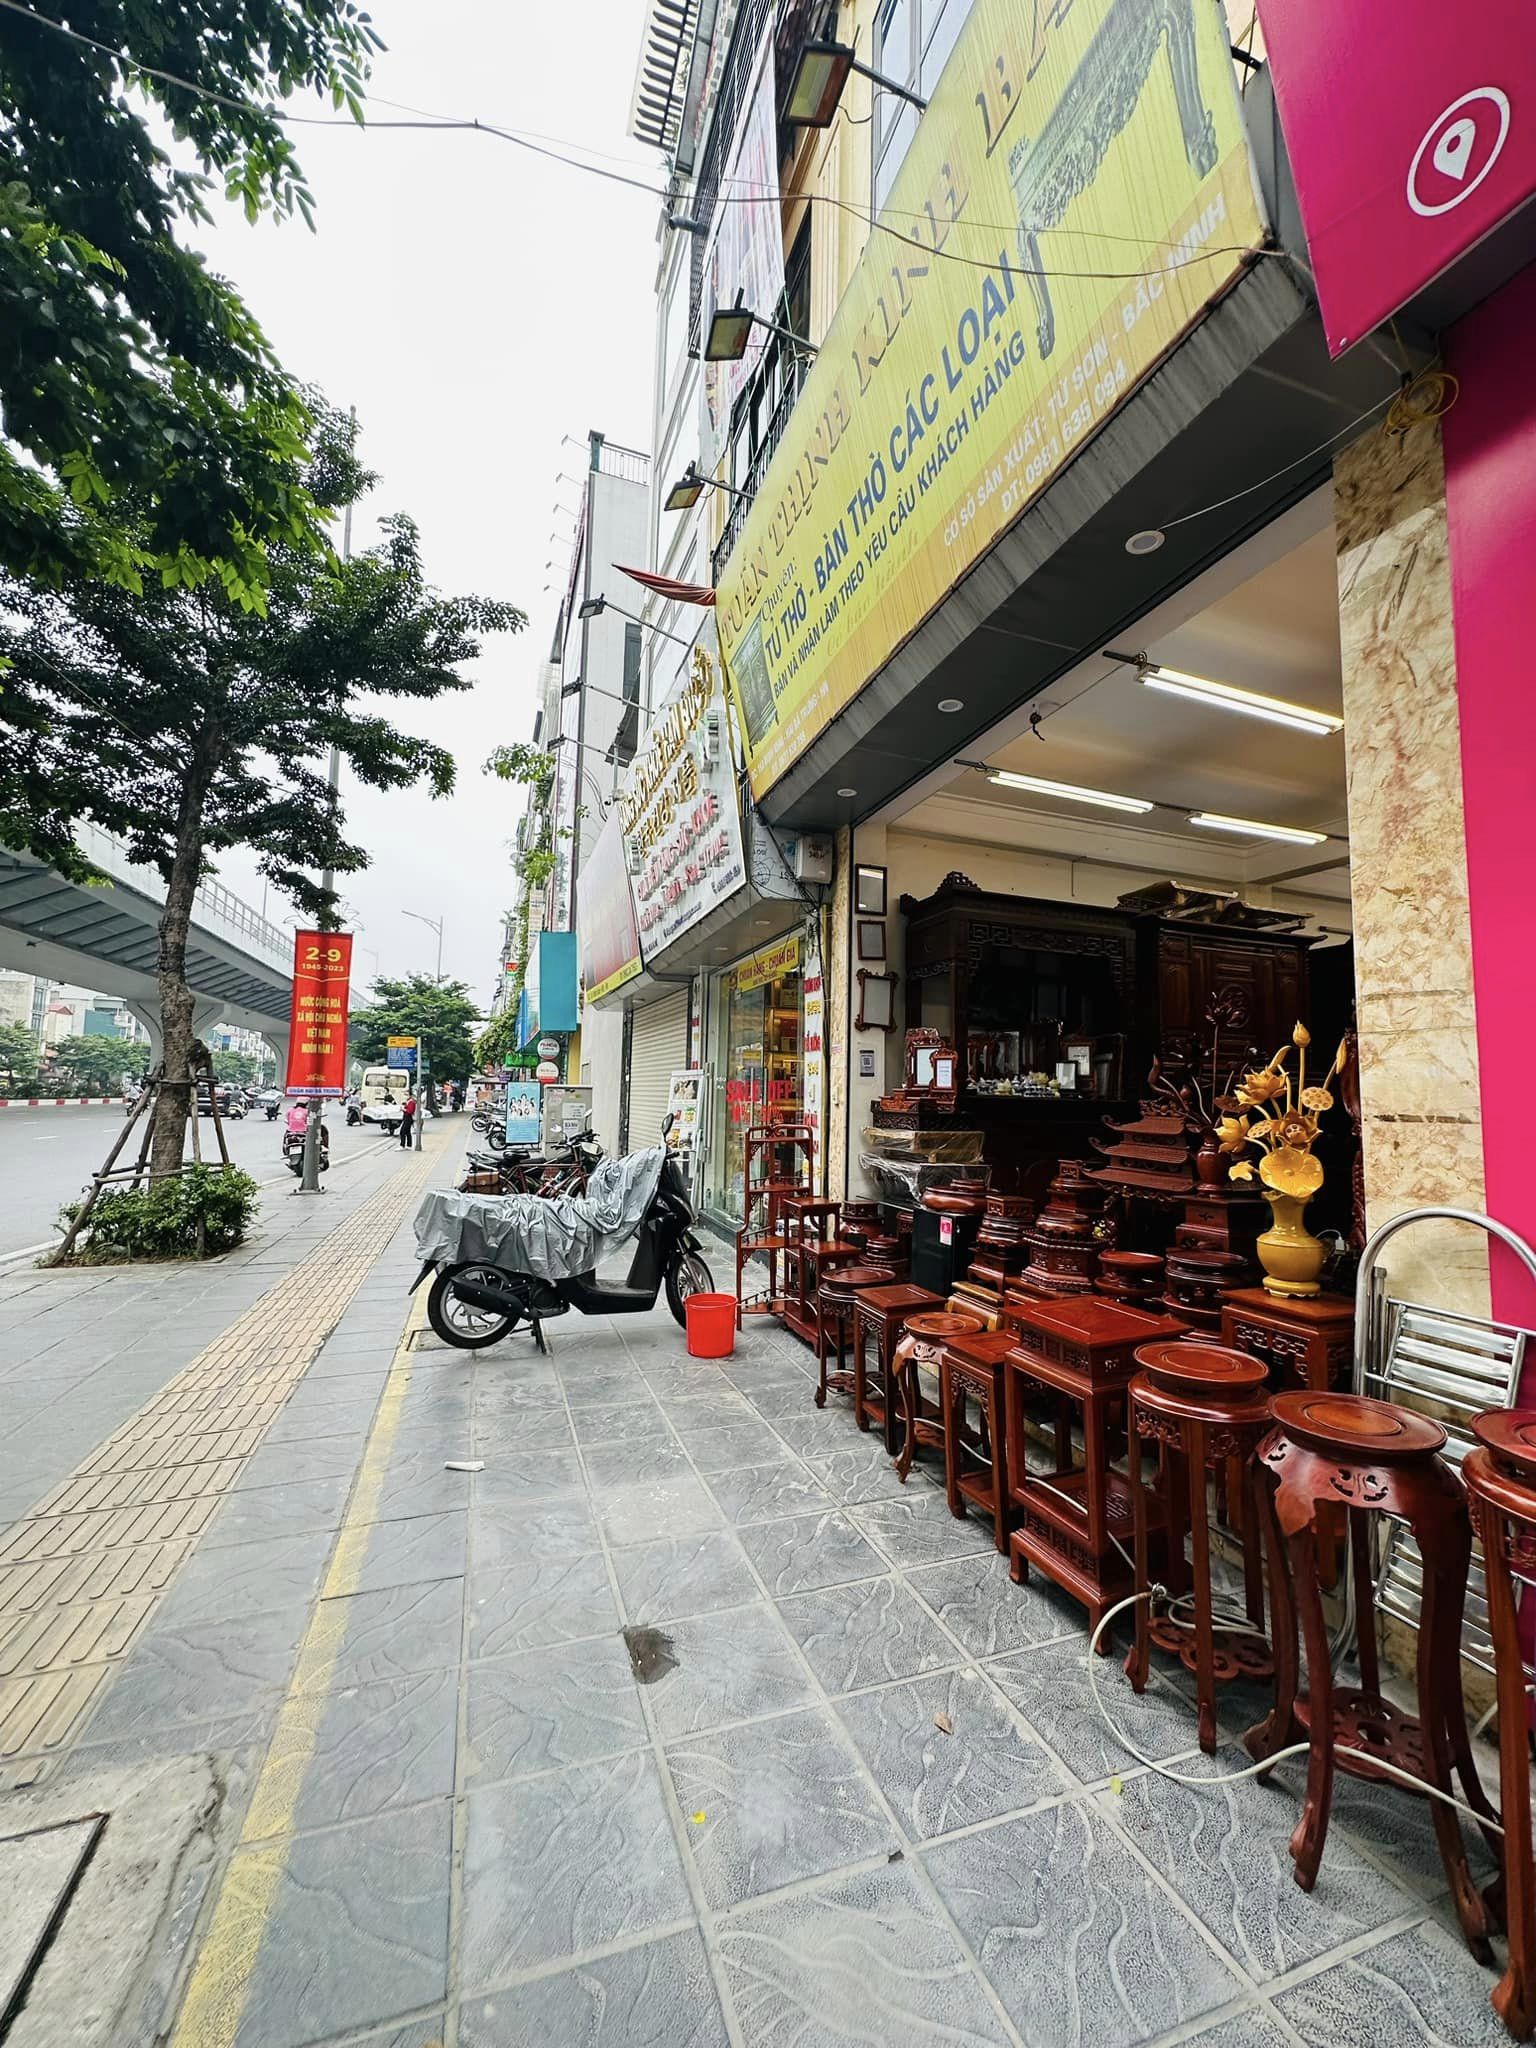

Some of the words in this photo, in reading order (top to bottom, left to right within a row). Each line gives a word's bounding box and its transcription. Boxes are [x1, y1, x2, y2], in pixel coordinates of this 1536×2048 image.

[765, 618, 782, 668] TỦ
[781, 582, 807, 641] THỜ
[814, 519, 848, 594] BÀN
[848, 449, 887, 537] THỜ
[889, 372, 940, 473] CÁC
[942, 249, 1016, 391] LOẠI
[768, 375, 852, 557] THỊNH
[852, 162, 970, 397] KINH
[977, 466, 1003, 505] SẢN
[1004, 414, 1048, 472] XUẤT:
[1048, 379, 1070, 416] TỪ
[1072, 341, 1108, 389] SƠN
[1166, 196, 1225, 274] NINH
[1002, 480, 1024, 512] ĐT:
[1027, 438, 1058, 483] 0981
[1063, 403, 1091, 439] 635
[1096, 360, 1125, 403] 094
[760, 556, 799, 622] Chuyên:
[774, 673, 788, 698] BÁN
[787, 655, 800, 678] VÀ
[799, 626, 821, 664] NHẬN
[821, 599, 839, 633] LÀM
[838, 561, 864, 606] THEO
[864, 526, 888, 568] YÊU
[890, 487, 916, 535] CẦU
[916, 412, 970, 494] KHÁCH
[970, 331, 1027, 421] HÀNG
[301, 962, 344, 973] 1945-2023
[305, 946, 342, 962] 2-9
